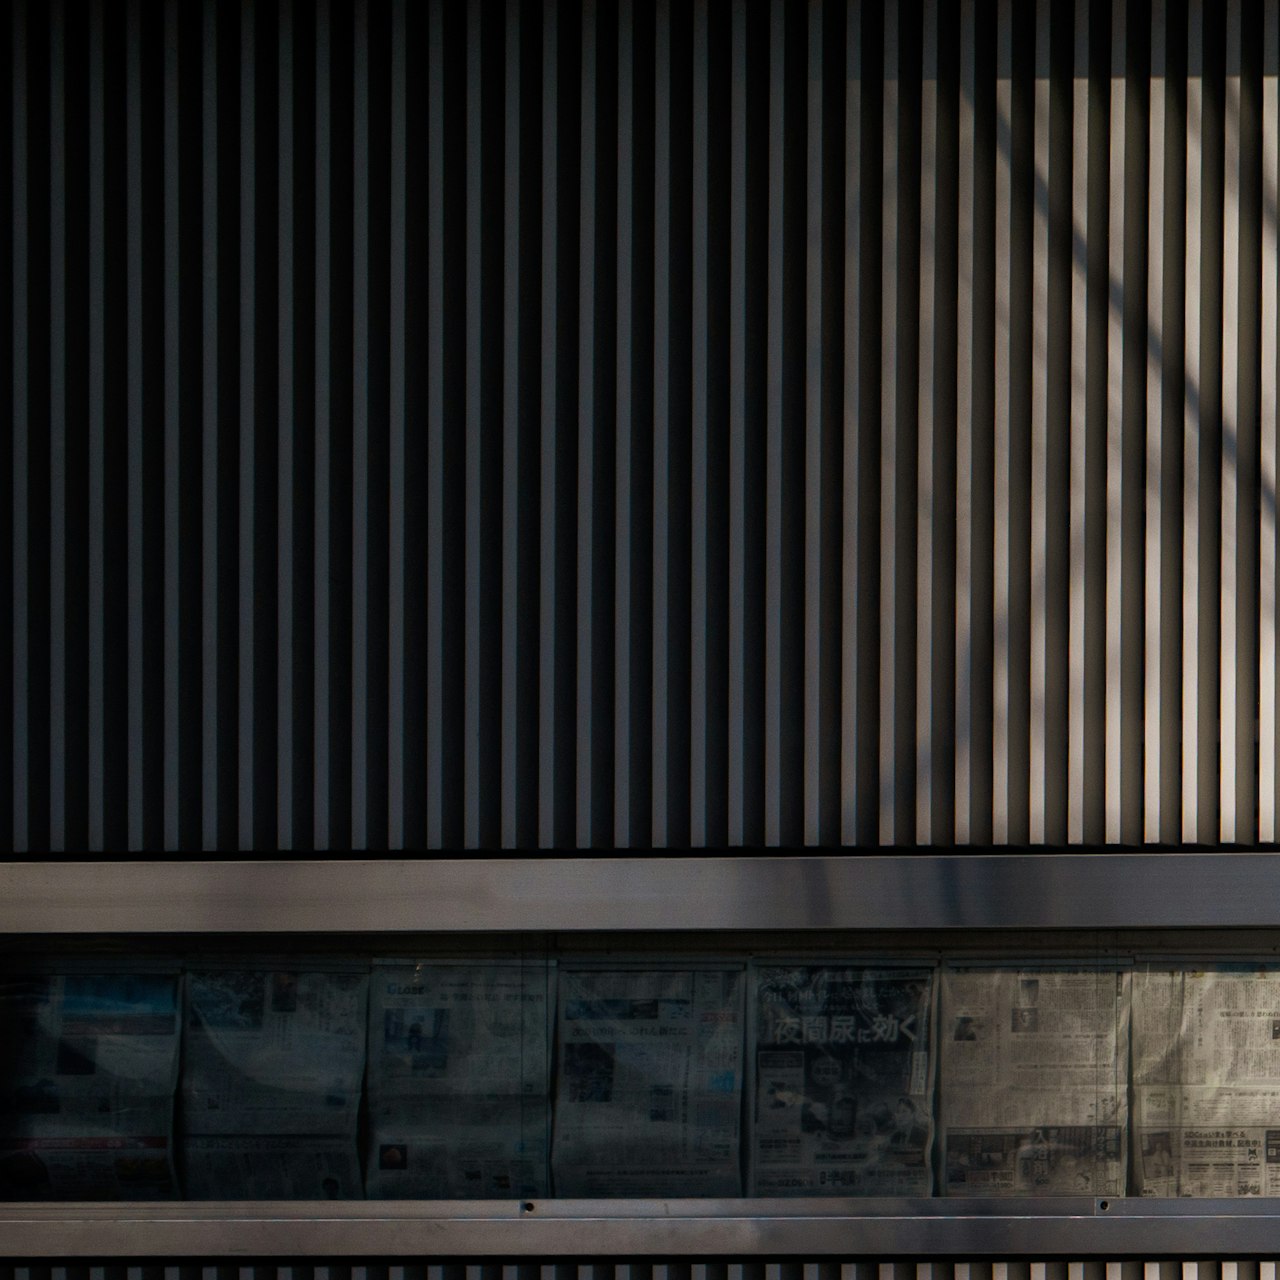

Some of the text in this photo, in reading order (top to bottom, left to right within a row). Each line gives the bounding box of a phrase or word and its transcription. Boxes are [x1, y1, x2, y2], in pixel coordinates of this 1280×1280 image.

[774, 1014, 918, 1044] 夜間尿に効く
